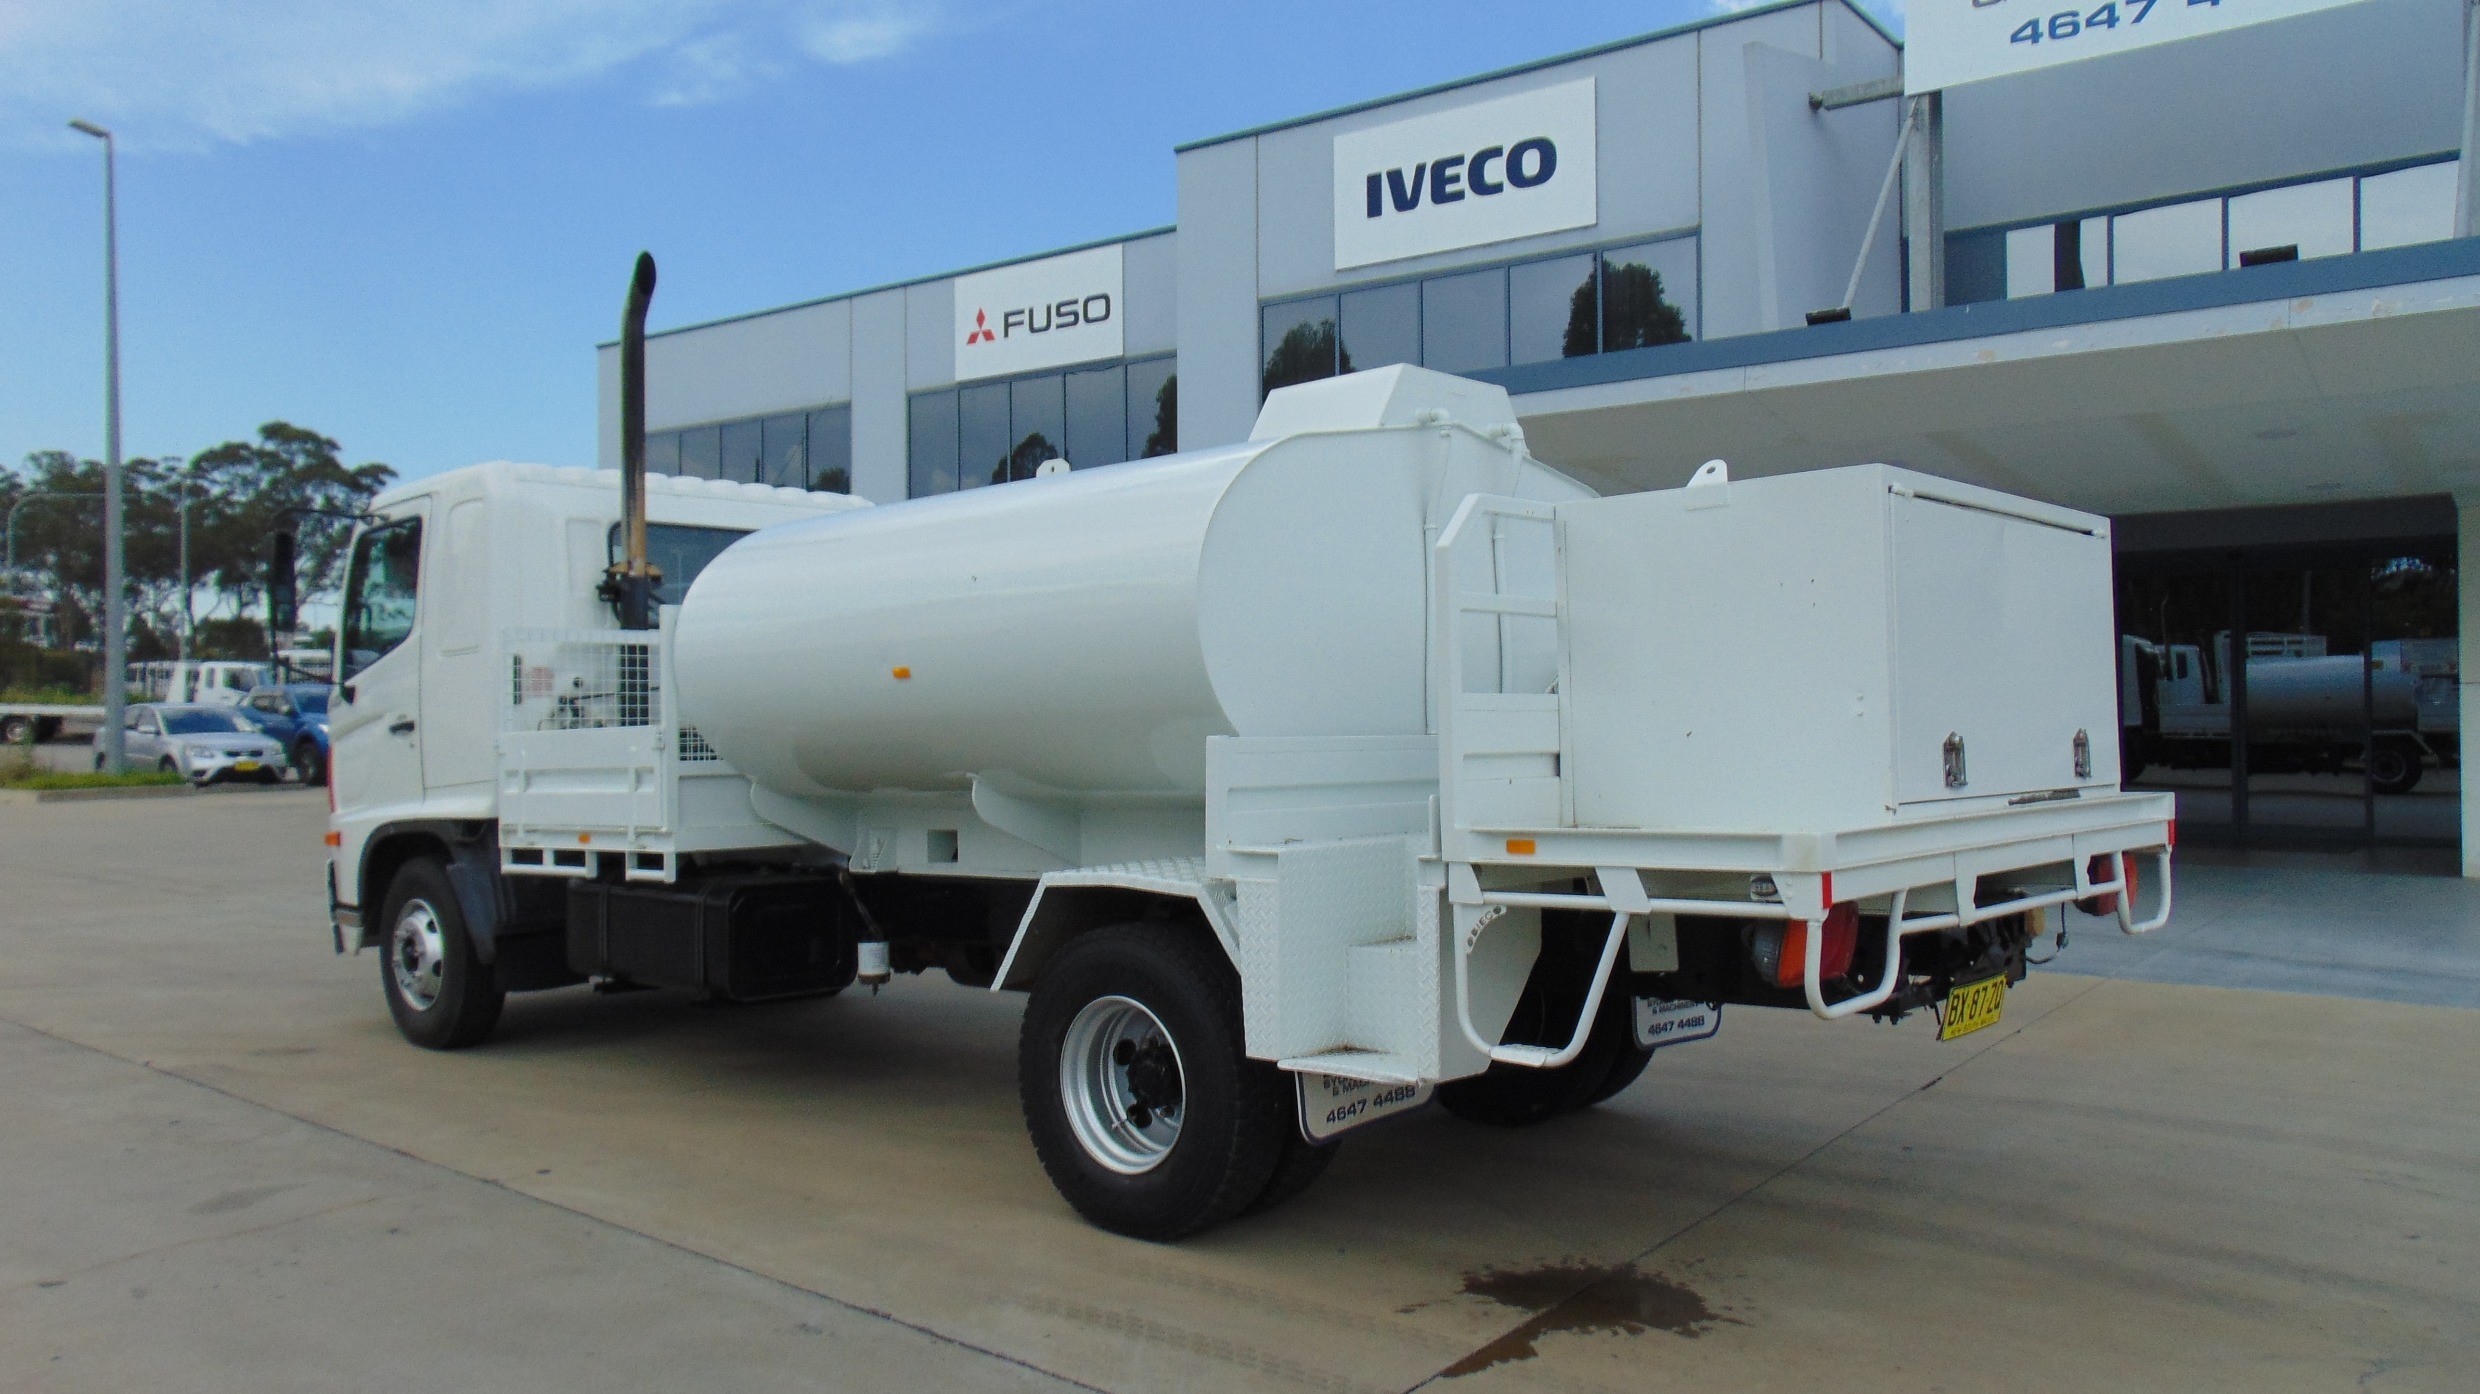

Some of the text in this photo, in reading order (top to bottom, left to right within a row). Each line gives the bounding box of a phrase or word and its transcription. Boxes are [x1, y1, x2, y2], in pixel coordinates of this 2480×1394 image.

[2010, 0, 2156, 45] 4647
[1366, 136, 1557, 219] IVECO
[1003, 292, 1111, 338] FUSO
[1648, 1015, 1705, 1035] 4647 4488
[1326, 1099, 1368, 1124] 4647
[1373, 1084, 1416, 1108] 4488
